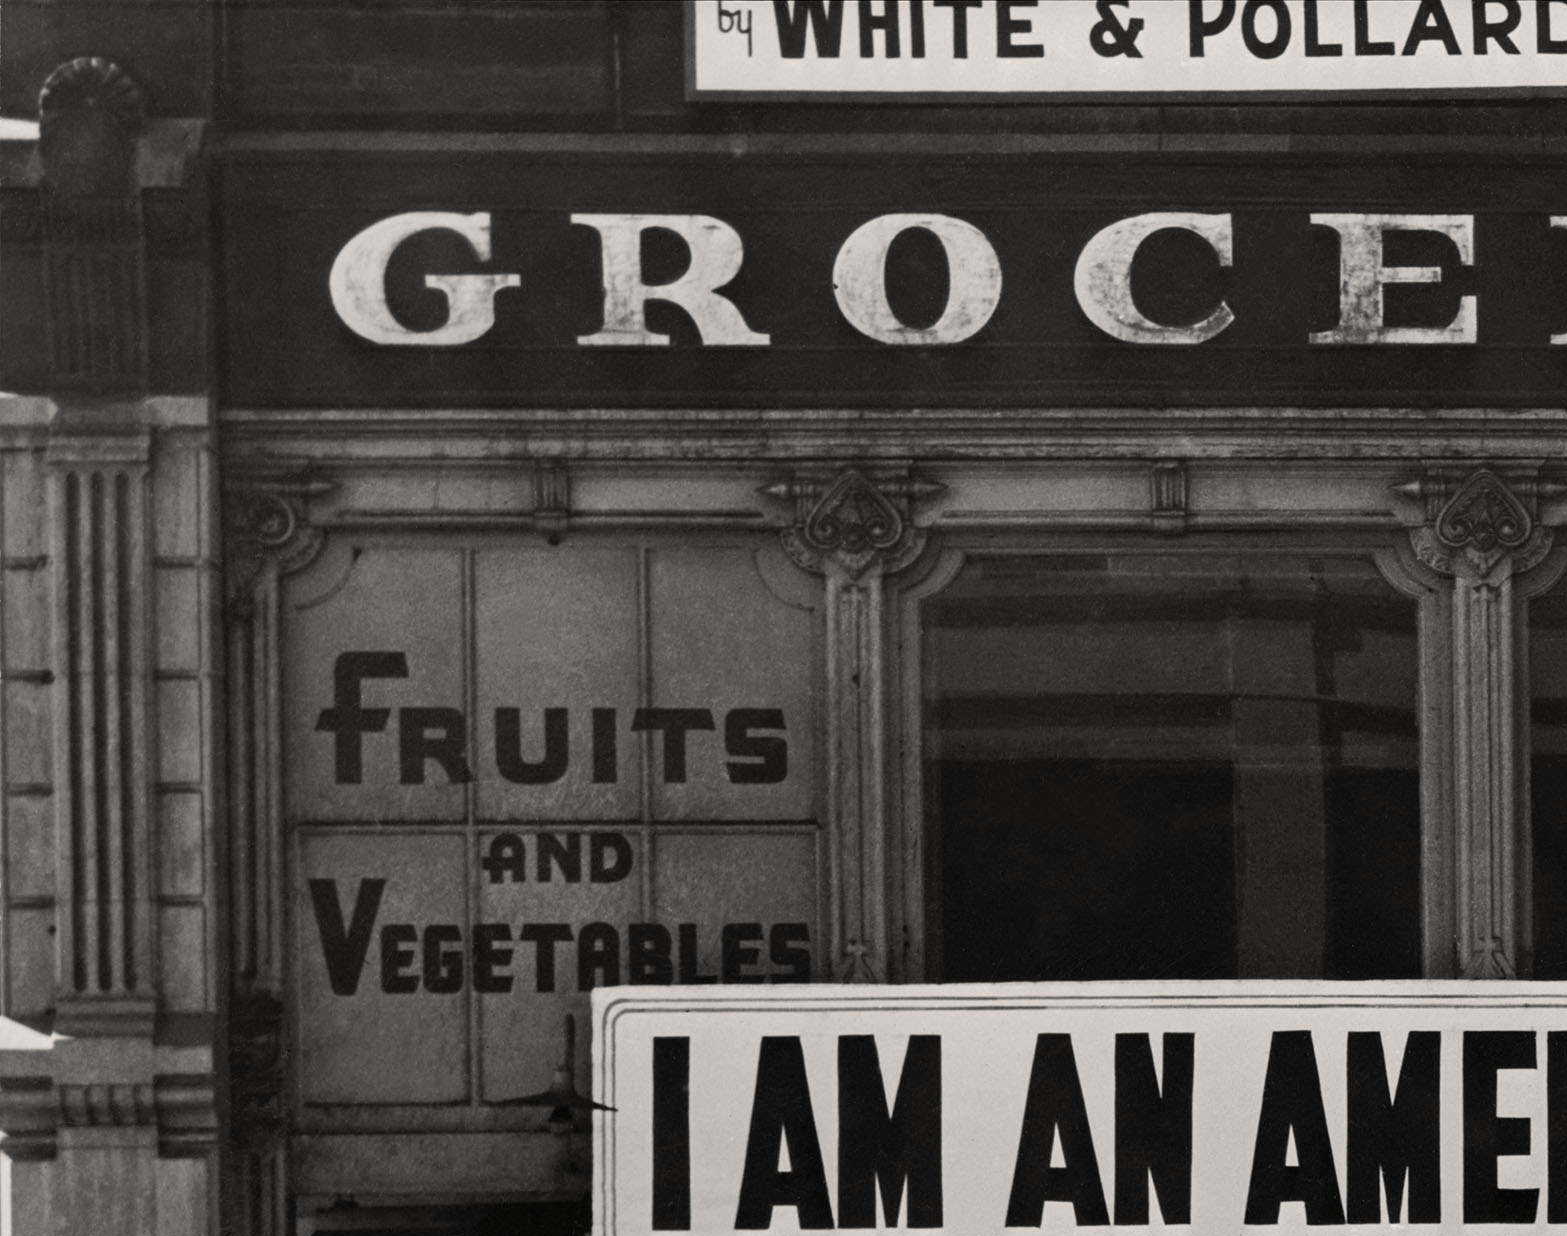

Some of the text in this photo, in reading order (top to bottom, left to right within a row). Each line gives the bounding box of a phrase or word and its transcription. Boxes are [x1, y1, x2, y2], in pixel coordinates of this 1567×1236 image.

[717, 0, 754, 57] by
[772, 0, 1045, 60] WHITE
[1088, 0, 1146, 59] &
[482, 832, 634, 884] AND
[308, 878, 813, 996] VEGETABLES
[650, 1036, 691, 1231] I
[732, 1034, 945, 1231] AM
[1004, 1032, 1195, 1228] AN
